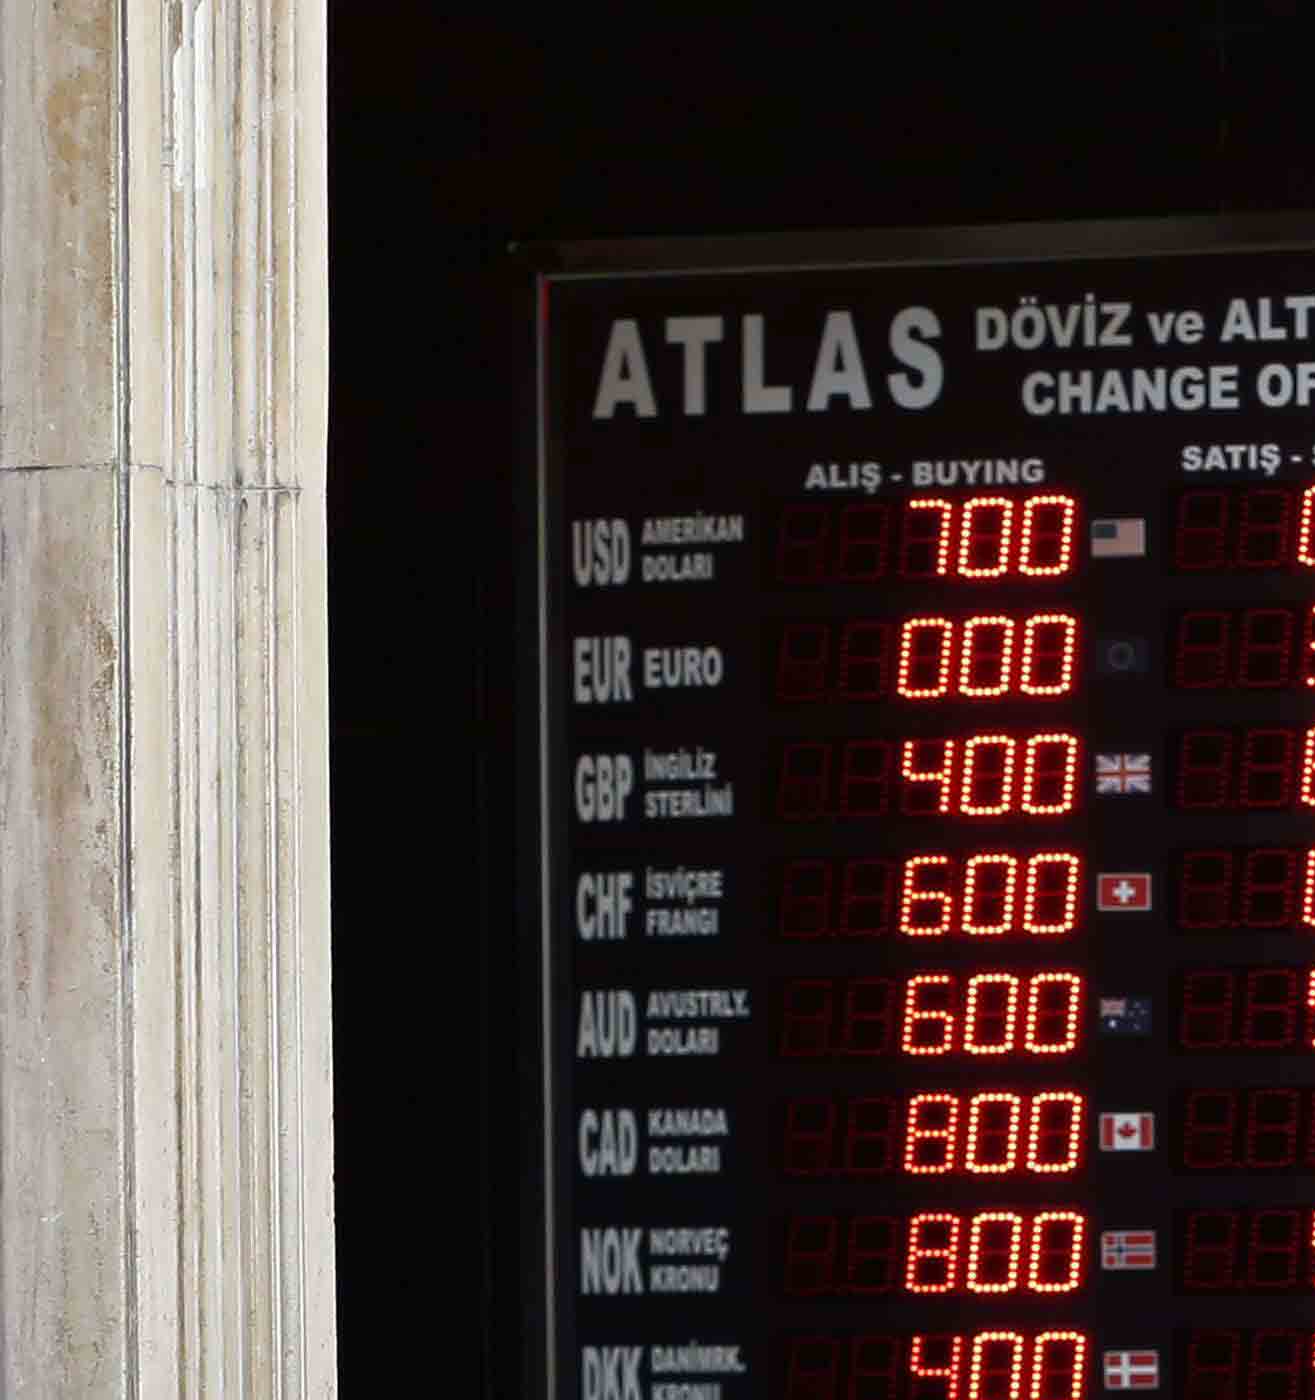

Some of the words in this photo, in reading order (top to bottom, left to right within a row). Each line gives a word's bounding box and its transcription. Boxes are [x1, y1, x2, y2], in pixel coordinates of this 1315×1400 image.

[593, 306, 944, 419] ATLAS
[976, 292, 1133, 351] DÖVİZ
[1147, 310, 1205, 345] ve
[1021, 364, 1241, 416] CHANGE
[804, 461, 882, 494] ALIŞ
[912, 457, 1045, 487] BUYING
[1181, 442, 1282, 476] SATIŞ
[572, 518, 631, 587] USD
[641, 511, 743, 545] AMERİKAN
[909, 493, 1076, 580] 700
[642, 553, 713, 582] DOLARI
[574, 636, 633, 703] EUR
[644, 646, 723, 689] EURO
[896, 613, 1079, 700] 000
[575, 754, 633, 822] GBP
[900, 732, 1081, 817] 400
[576, 872, 633, 940] CHF
[645, 866, 723, 905] İSVİÇRE
[898, 851, 1082, 937] 600
[577, 989, 637, 1058] AUD
[647, 1027, 719, 1056] DOLARI
[901, 971, 1085, 1056] 600
[579, 1108, 638, 1177] CAD
[647, 1108, 729, 1137] KANADA
[903, 1088, 1087, 1175] 800
[648, 1145, 721, 1174] DOLARI
[581, 1227, 644, 1295] NOK
[649, 1227, 729, 1261] NORVEÇ
[904, 1209, 1088, 1297] 800
[650, 1264, 720, 1293] KRONU
